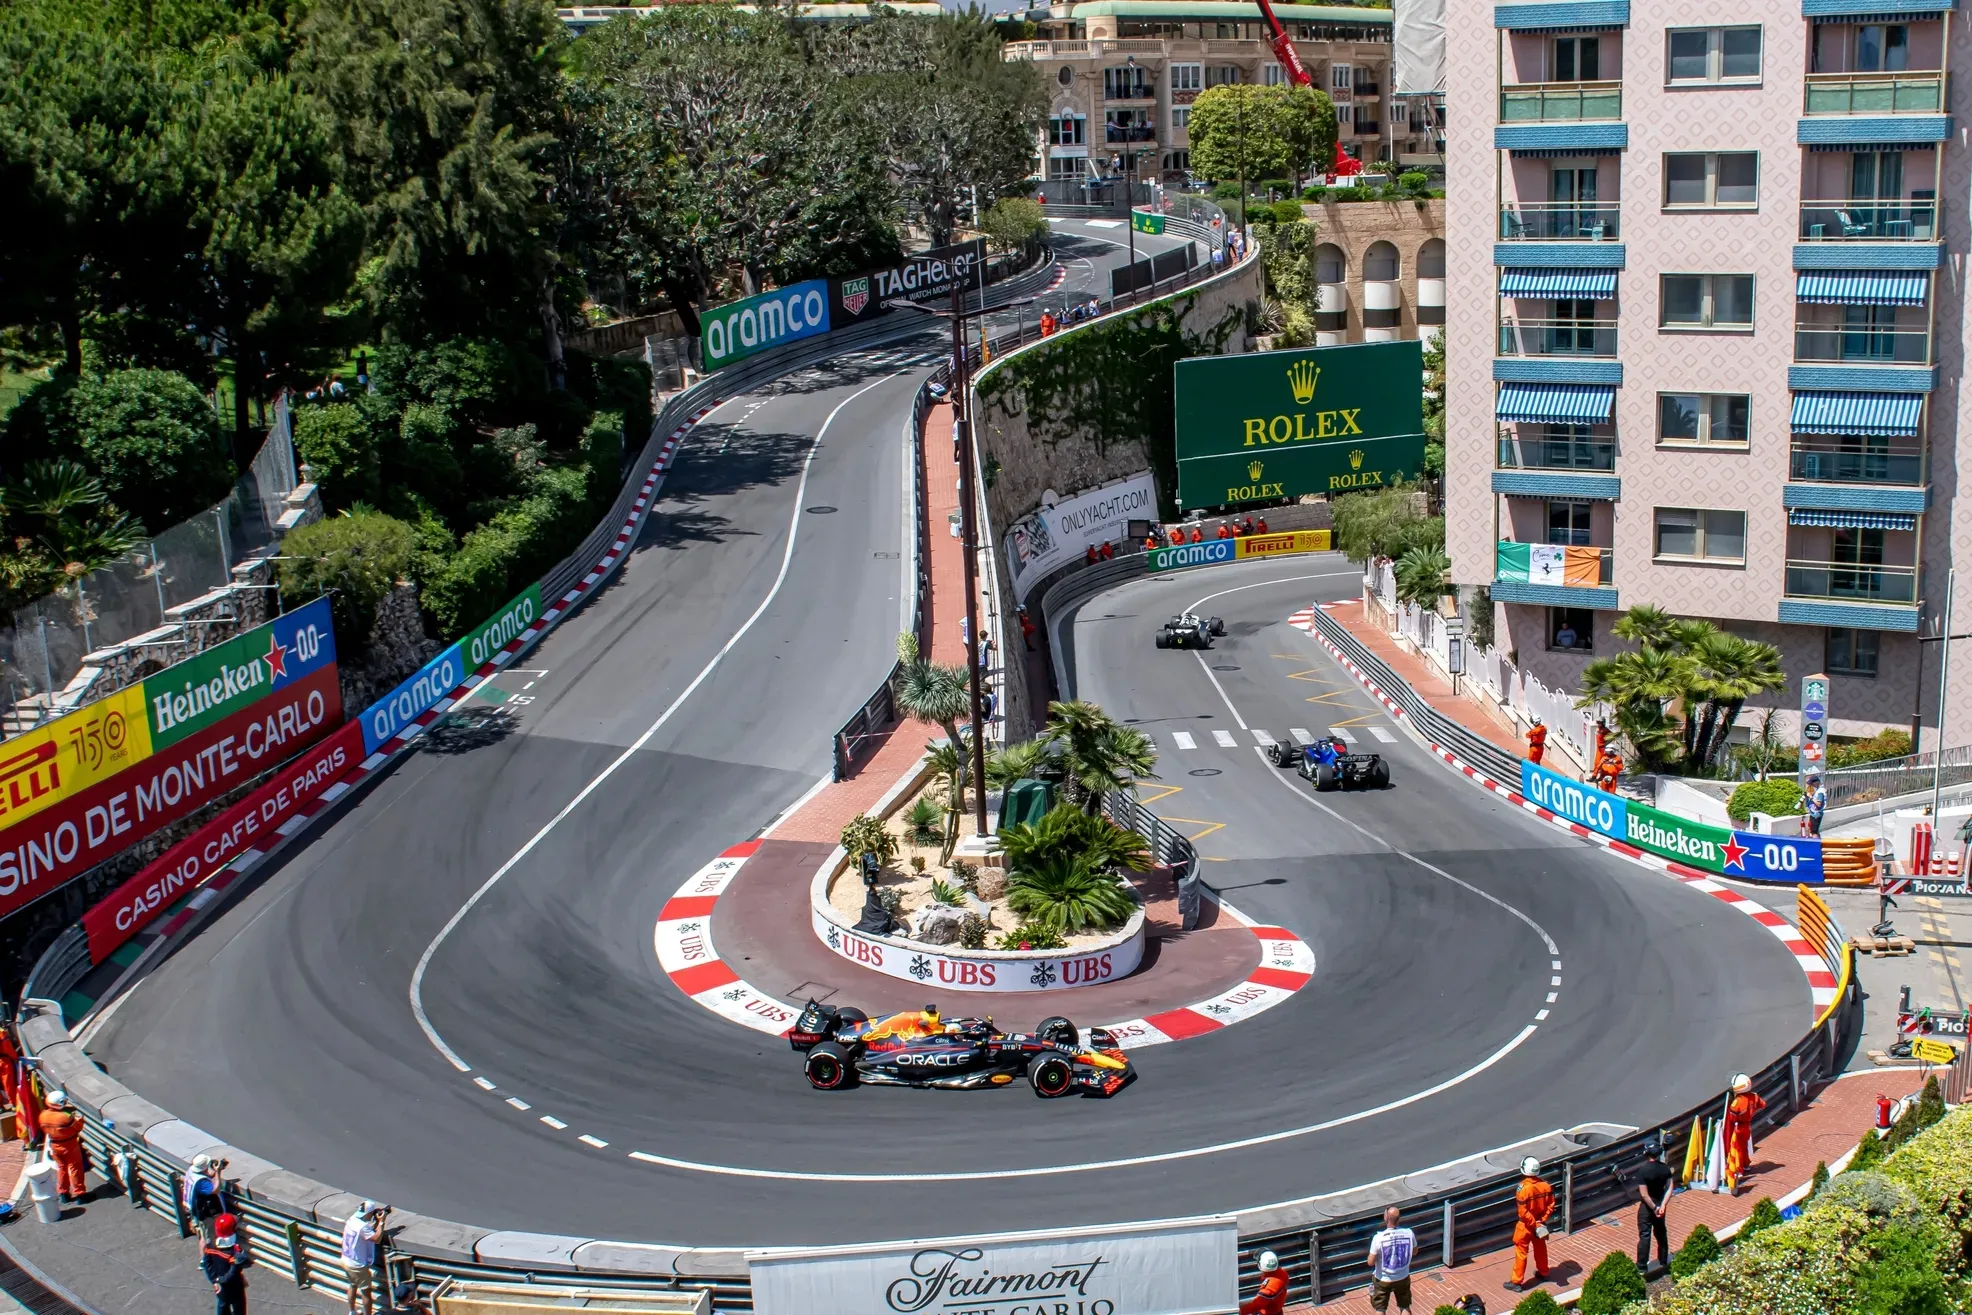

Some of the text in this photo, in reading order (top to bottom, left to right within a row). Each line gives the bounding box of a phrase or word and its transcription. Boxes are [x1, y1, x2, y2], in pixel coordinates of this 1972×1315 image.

[844, 279, 867, 294] TAG
[908, 288, 932, 301] WATCH
[932, 279, 961, 296] MONAO
[707, 289, 824, 360] aramco
[1243, 407, 1362, 447] ROLEX
[1227, 482, 1284, 502] ROLEX
[1329, 470, 1382, 489] ROLEX
[1061, 489, 1149, 535] ONLYYACHT.COM
[1157, 543, 1227, 568] aramco
[1245, 535, 1294, 554] PIRELLI
[471, 597, 533, 665] aramco
[153, 656, 264, 734] Heineken
[374, 659, 454, 740] aramco
[85, 791, 132, 849] DE
[136, 690, 324, 822] MONTE-CARLO
[1530, 771, 1614, 832] aramco
[115, 746, 346, 931] CASINO CAFE DE PARIS
[1626, 812, 1717, 862] Heineken
[694, 872, 727, 893] UBS
[678, 935, 706, 961] UBS
[842, 934, 884, 967] UBS
[1272, 942, 1294, 957] UBS
[937, 959, 996, 987] UBS
[1061, 953, 1113, 985] UBS
[1224, 986, 1267, 1006] UBS
[744, 999, 795, 1023] UBS
[1106, 1025, 1146, 1040] BS
[896, 1054, 970, 1067] ORACLE
[886, 1248, 1110, 1313] Fairmont
